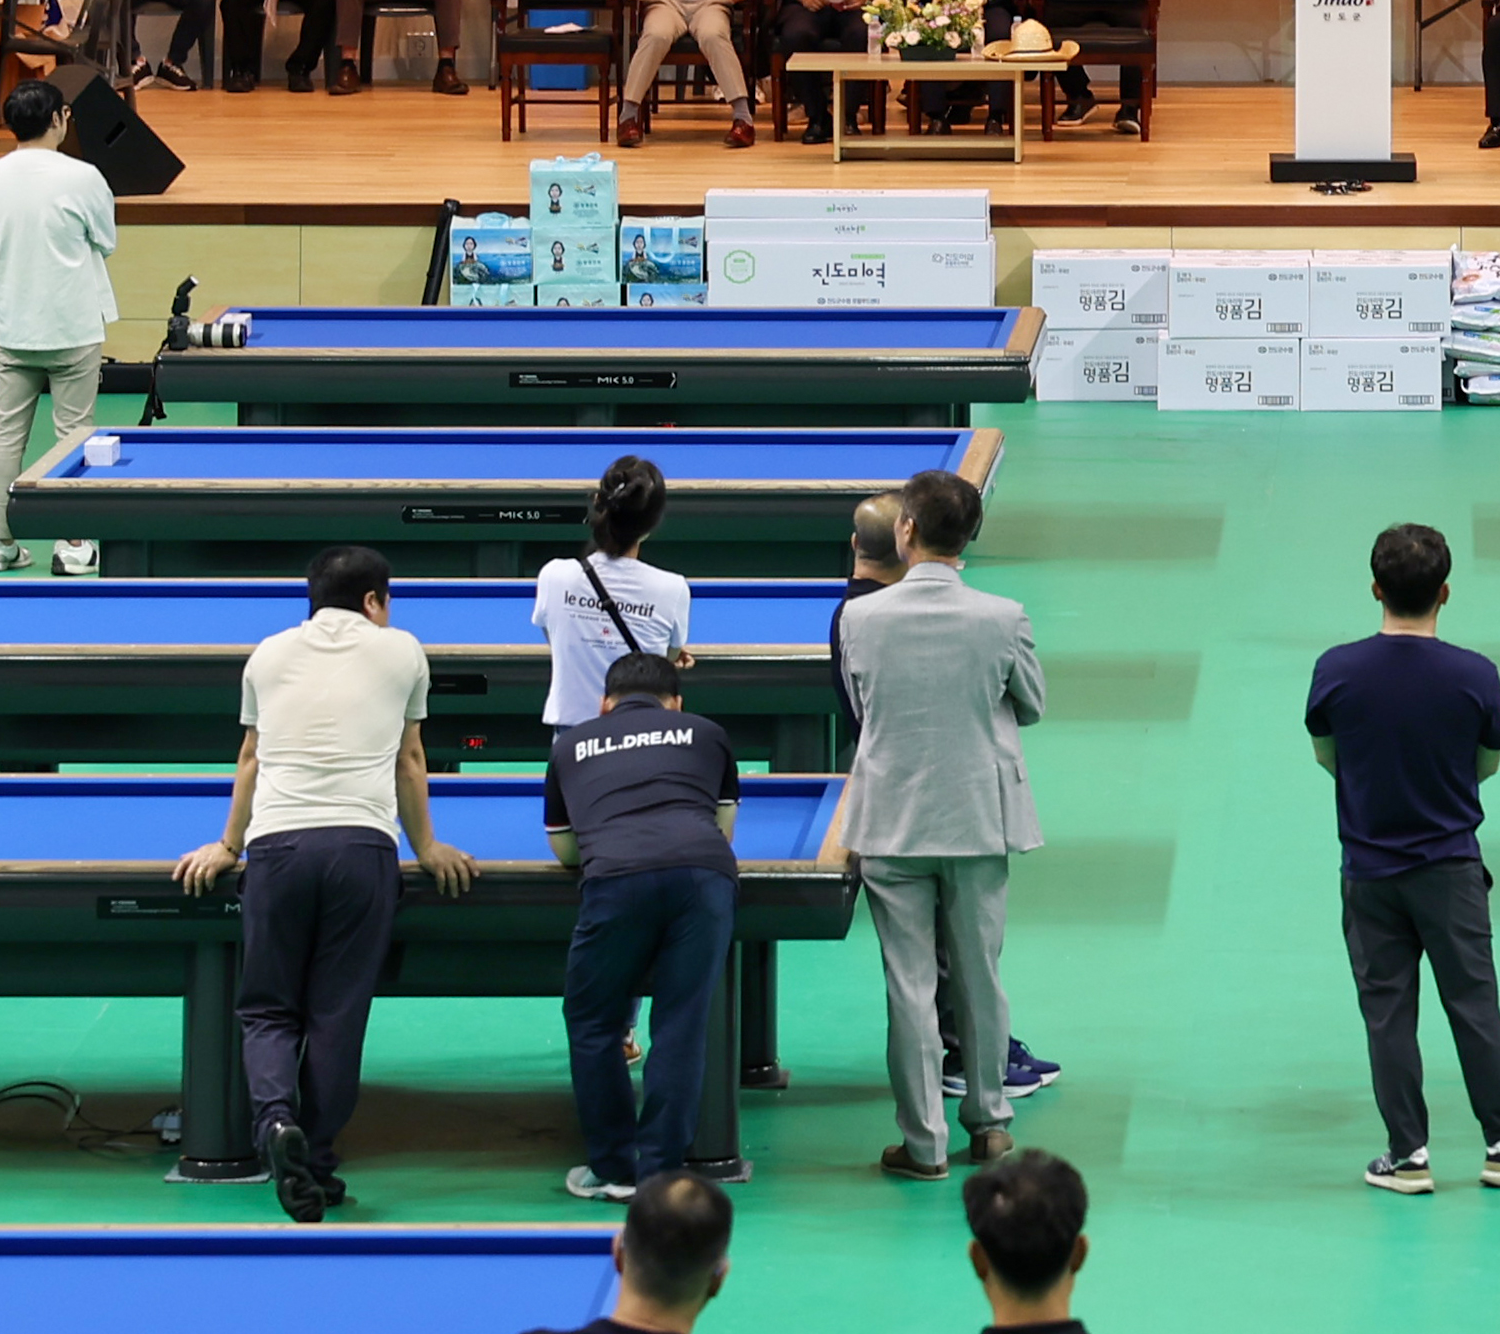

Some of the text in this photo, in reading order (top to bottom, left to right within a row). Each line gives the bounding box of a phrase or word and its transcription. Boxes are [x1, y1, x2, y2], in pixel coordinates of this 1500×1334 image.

[812, 261, 886, 289] 진도미역
[622, 376, 634, 385] 5.0
[526, 511, 540, 520] 5.0
[564, 590, 577, 606] le
[609, 598, 655, 618] portif
[575, 727, 694, 763] BILL.DREAM
